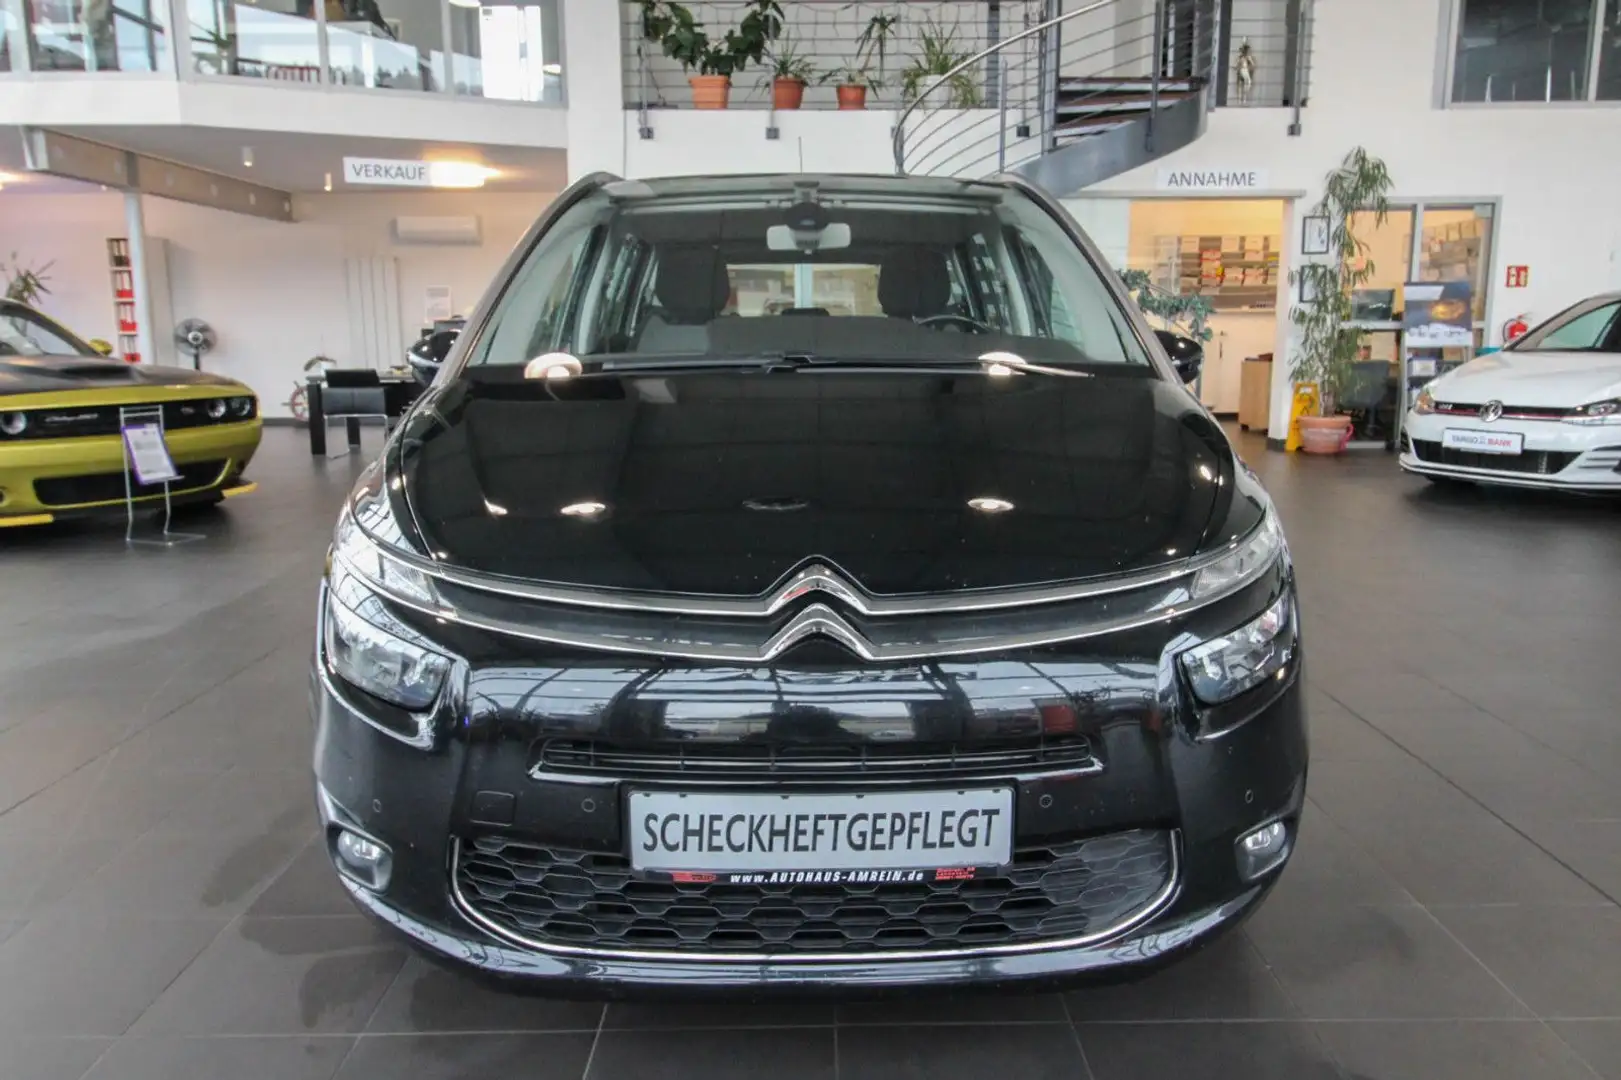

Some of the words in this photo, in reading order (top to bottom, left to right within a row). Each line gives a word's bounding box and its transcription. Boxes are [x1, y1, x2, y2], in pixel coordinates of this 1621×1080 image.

[352, 163, 425, 181] VERKAUF
[1167, 171, 1256, 187] ANNAHME
[642, 808, 1001, 853] SCHECKHEFTGEPFLEGT
[730, 870, 924, 884] www.AUTOHAUS-AMREIN.de
